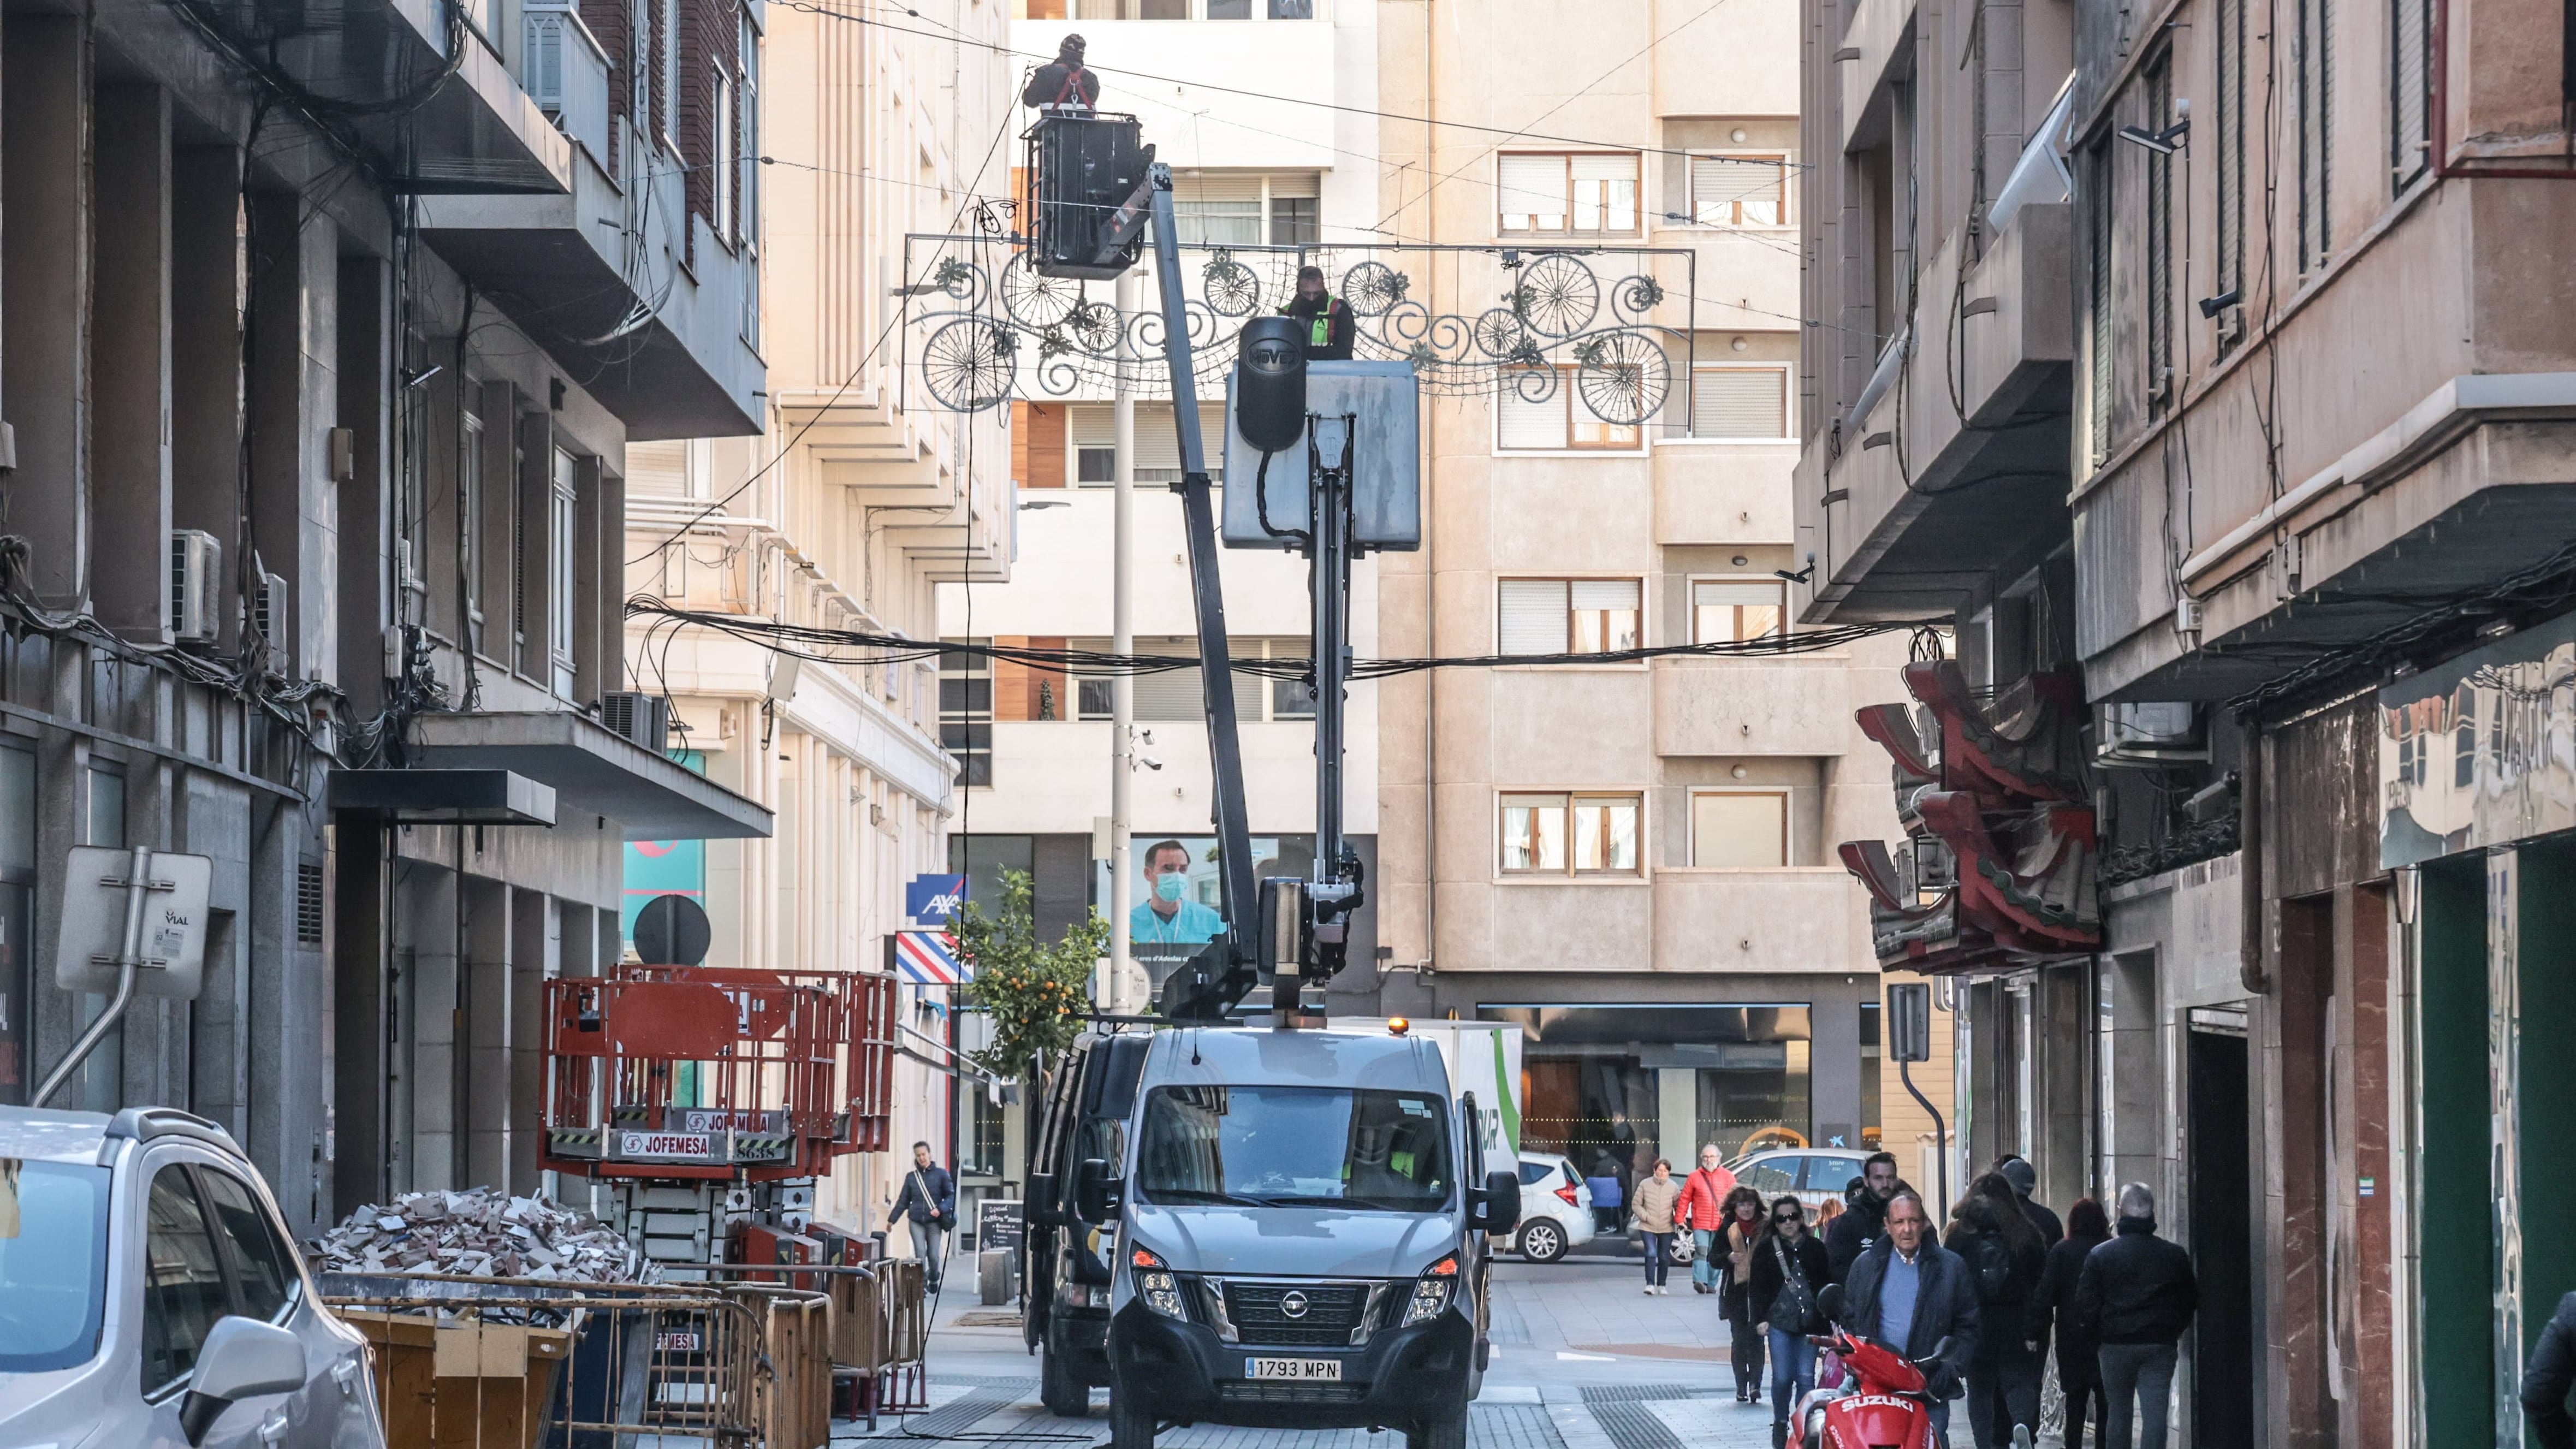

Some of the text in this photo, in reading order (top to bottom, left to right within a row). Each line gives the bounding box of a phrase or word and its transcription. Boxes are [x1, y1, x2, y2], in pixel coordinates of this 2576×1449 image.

[922, 894, 963, 914] AXA
[165, 913, 188, 925] VIAL
[709, 1115, 767, 1132] JOMA
[646, 1136, 708, 1155] JOFEMESA
[737, 1148, 775, 1159] 8638
[1259, 1361, 1297, 1376] 1793
[1305, 1362, 1336, 1377] MPN
[1841, 1395, 1913, 1413] SUZUKI
